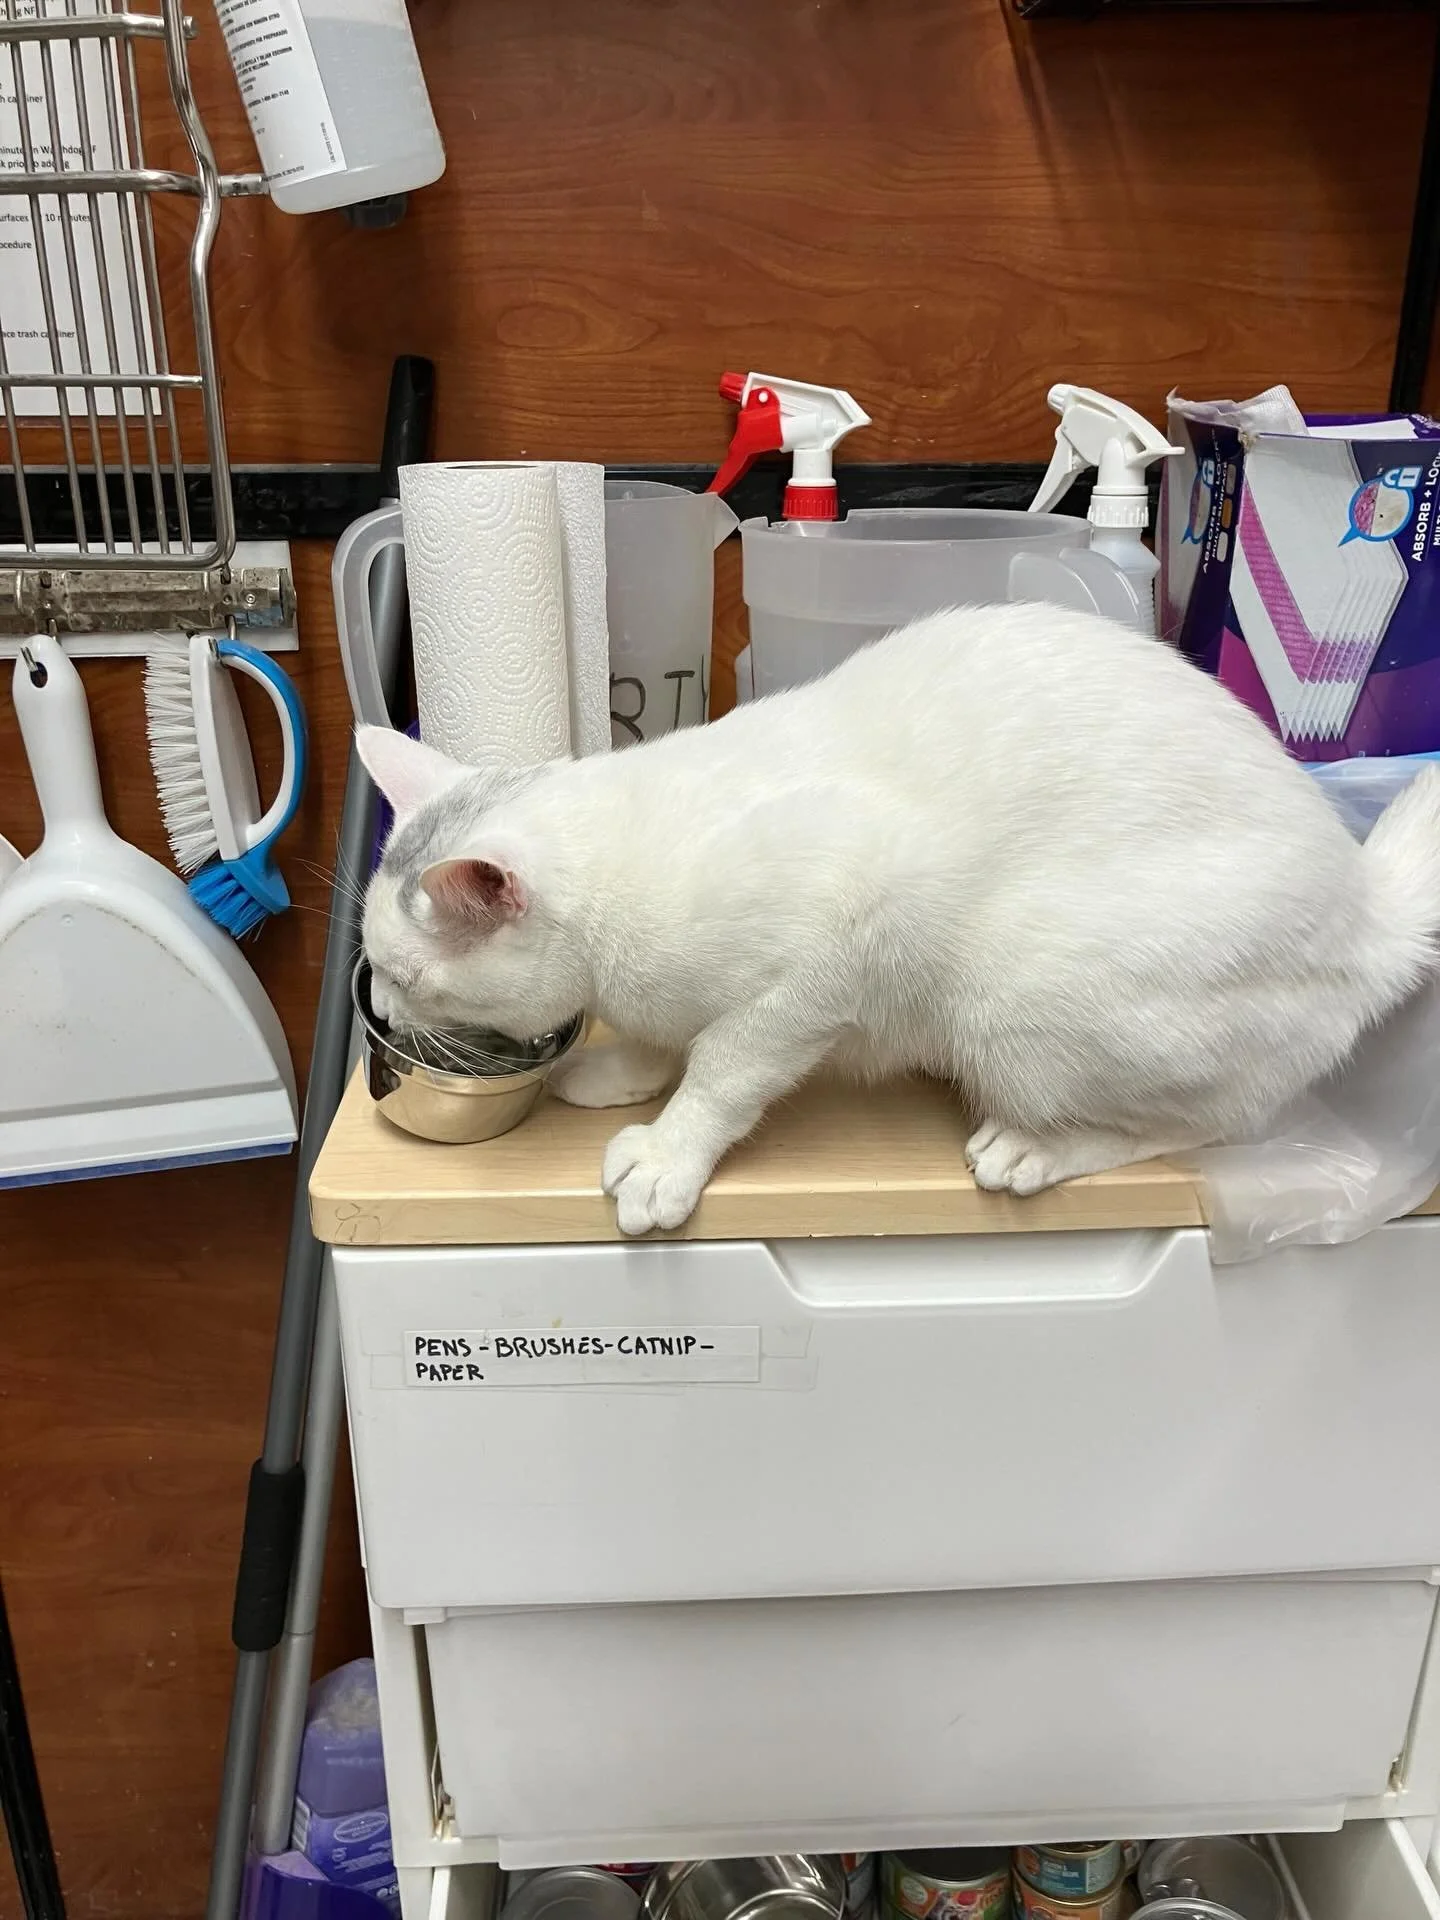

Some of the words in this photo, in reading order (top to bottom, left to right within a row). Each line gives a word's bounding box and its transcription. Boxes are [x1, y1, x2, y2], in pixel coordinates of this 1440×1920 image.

[8, 160, 25, 169] prio
[45, 213, 56, 222] 10
[17, 330, 39, 338] trash
[1411, 501, 1432, 562] ABSORB
[1423, 489, 1433, 499] +
[415, 1362, 485, 1382] PAPER
